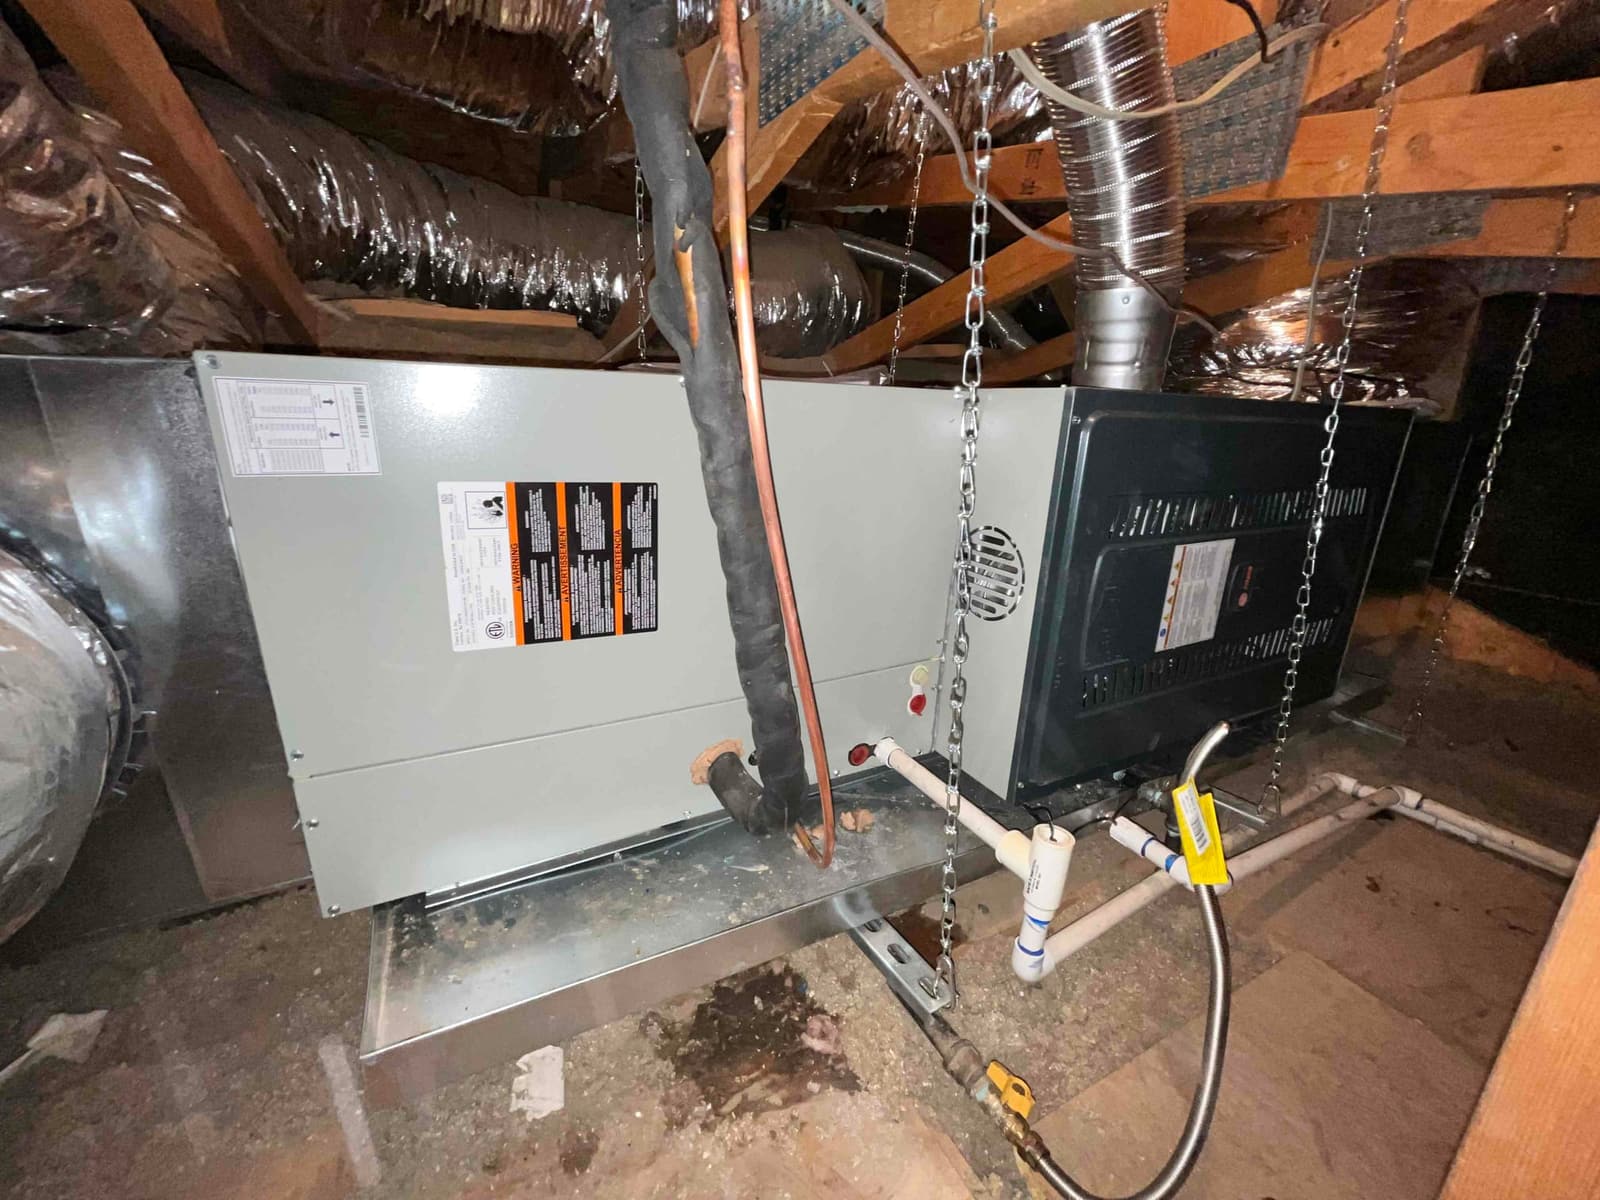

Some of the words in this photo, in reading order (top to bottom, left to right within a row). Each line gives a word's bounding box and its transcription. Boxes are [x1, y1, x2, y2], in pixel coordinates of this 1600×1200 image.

[511, 543, 521, 584] WARNING
[559, 527, 569, 595] AVERTISSEMENT
[614, 529, 623, 585] ADVERTENCIA
